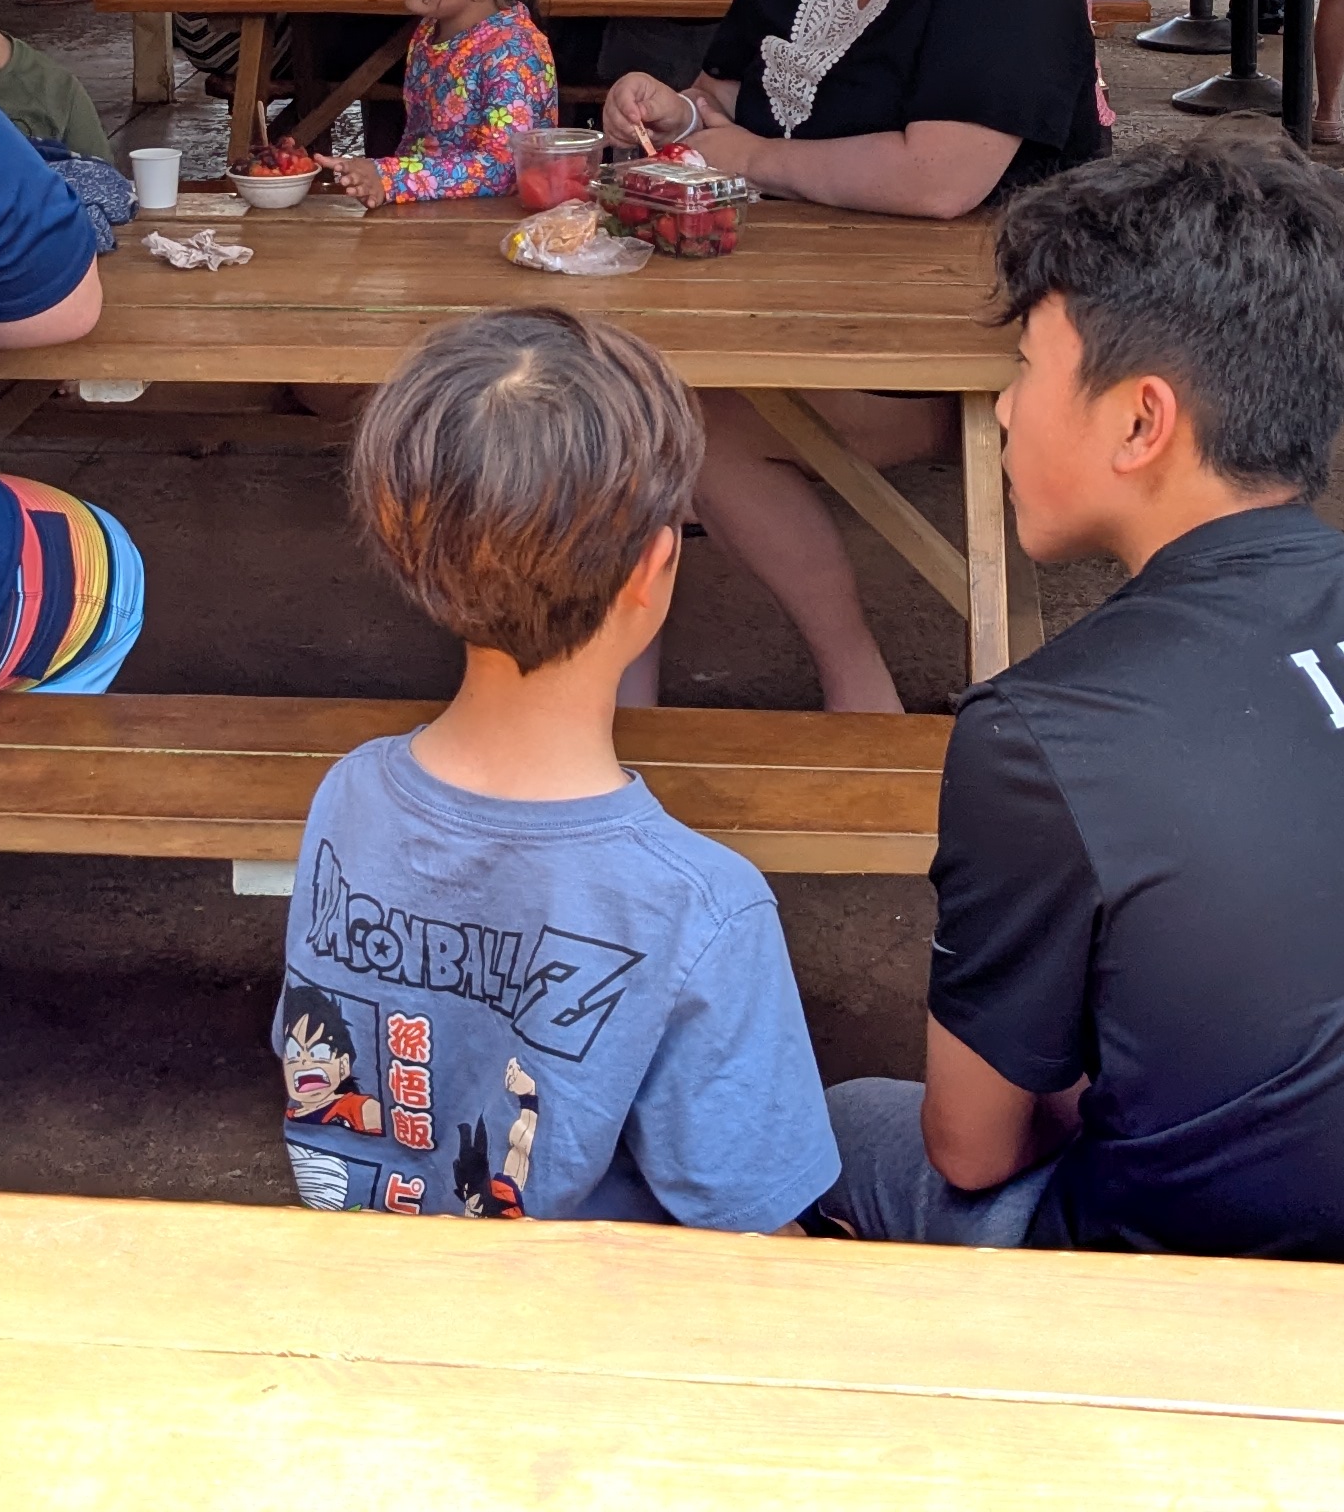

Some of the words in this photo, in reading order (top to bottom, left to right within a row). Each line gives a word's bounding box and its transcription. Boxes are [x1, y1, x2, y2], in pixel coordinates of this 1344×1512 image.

[514, 925, 646, 1061] Z
[387, 1011, 436, 1150] 孫悟飯
